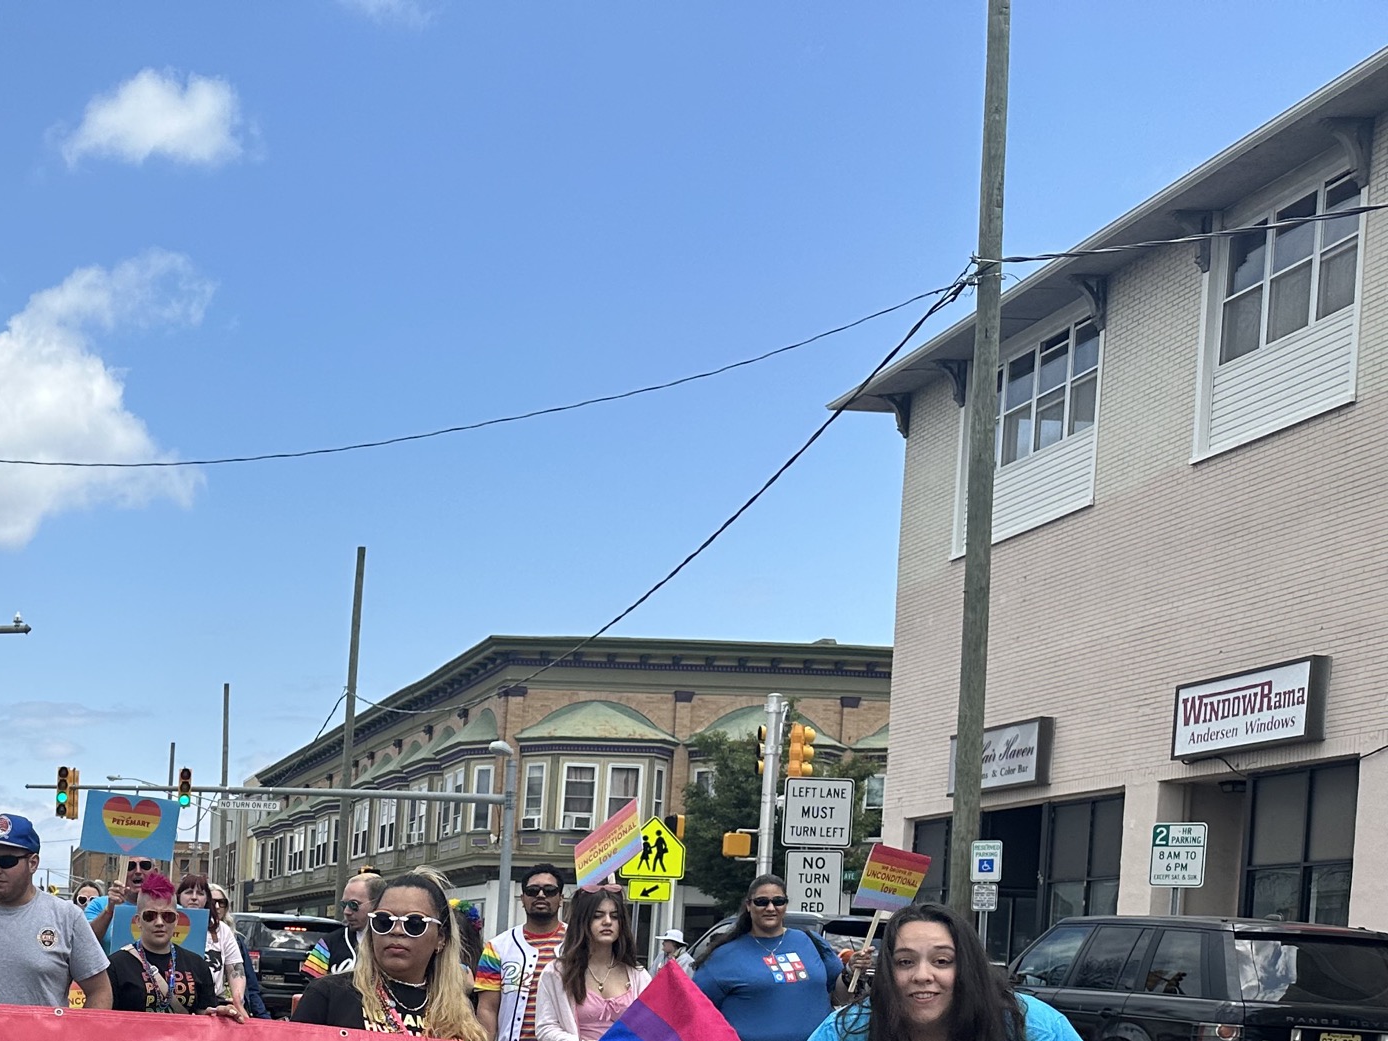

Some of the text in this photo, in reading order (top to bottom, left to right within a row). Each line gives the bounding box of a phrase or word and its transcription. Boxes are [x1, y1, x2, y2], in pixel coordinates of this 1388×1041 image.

[1188, 715, 1296, 745] Andersen Windows
[999, 733, 1035, 761] Haven
[999, 765, 1016, 777] Color
[1017, 763, 1029, 773] Bar
[792, 786, 847, 799] LEFT LANE
[801, 806, 836, 819] MUST
[790, 825, 845, 838] TURN LEFT
[1155, 827, 1168, 845] 2
[578, 821, 637, 870] UNCONDITIONAL
[1171, 836, 1202, 845] PARKING
[599, 847, 618, 865] love
[1158, 851, 1197, 860] 8 AM TO
[802, 857, 826, 869] NO
[1165, 862, 1188, 872] 6 PM
[798, 873, 830, 884] TURN
[843, 872, 855, 880] AVE
[867, 868, 919, 888] UNCONDITIONAL
[805, 888, 822, 899] ON
[880, 883, 898, 895] love
[800, 902, 825, 913] RED
[1286, 1016, 1340, 1026] RANGE
